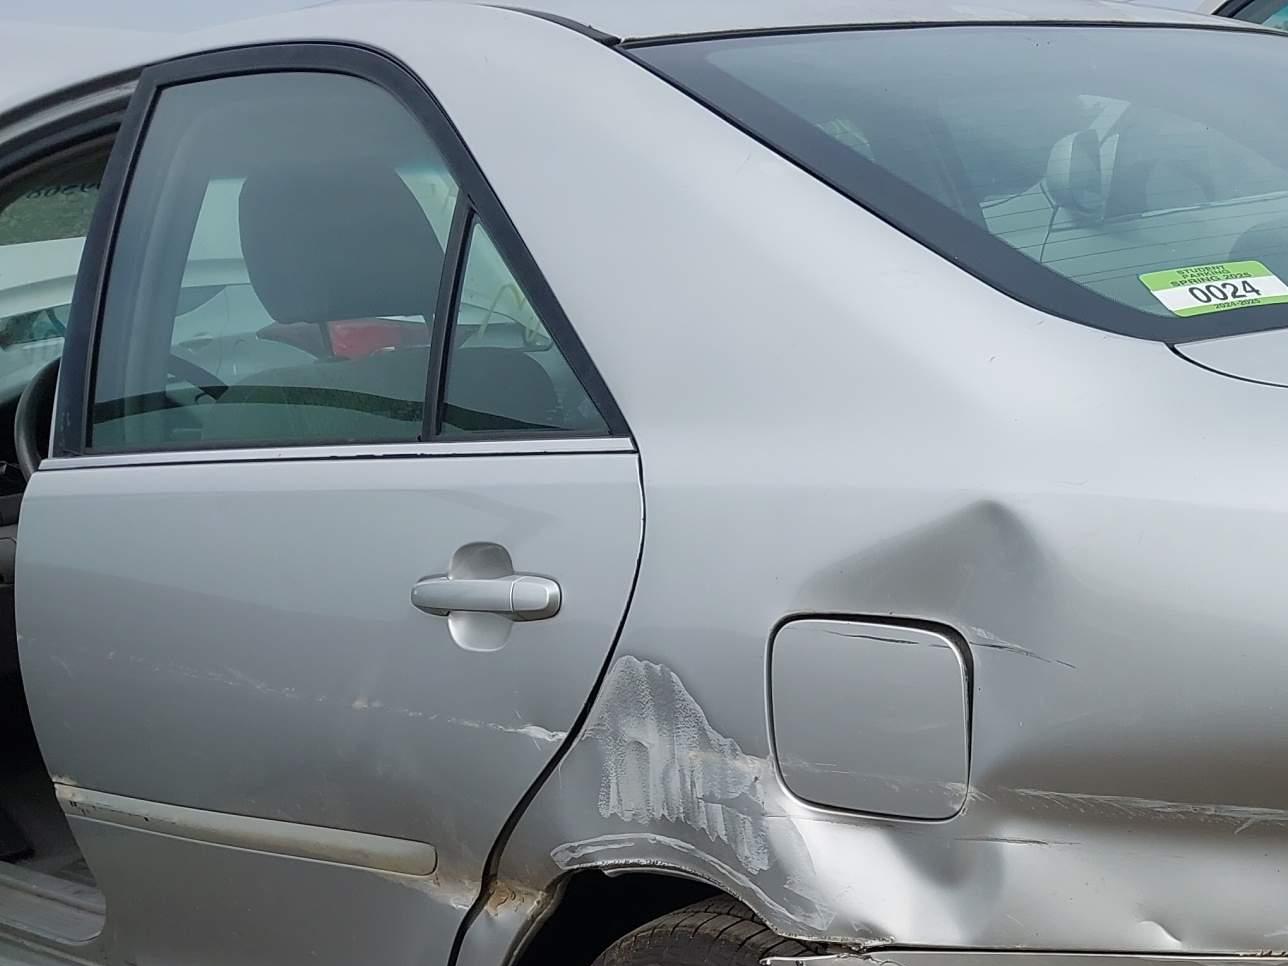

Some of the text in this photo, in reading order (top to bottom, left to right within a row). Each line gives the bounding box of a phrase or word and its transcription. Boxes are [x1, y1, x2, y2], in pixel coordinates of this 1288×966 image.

[1176, 265, 1225, 275] STUDENT
[1182, 269, 1231, 279] PARKING
[1169, 272, 1252, 287] SPRING 2025
[1188, 280, 1262, 303] 0024
